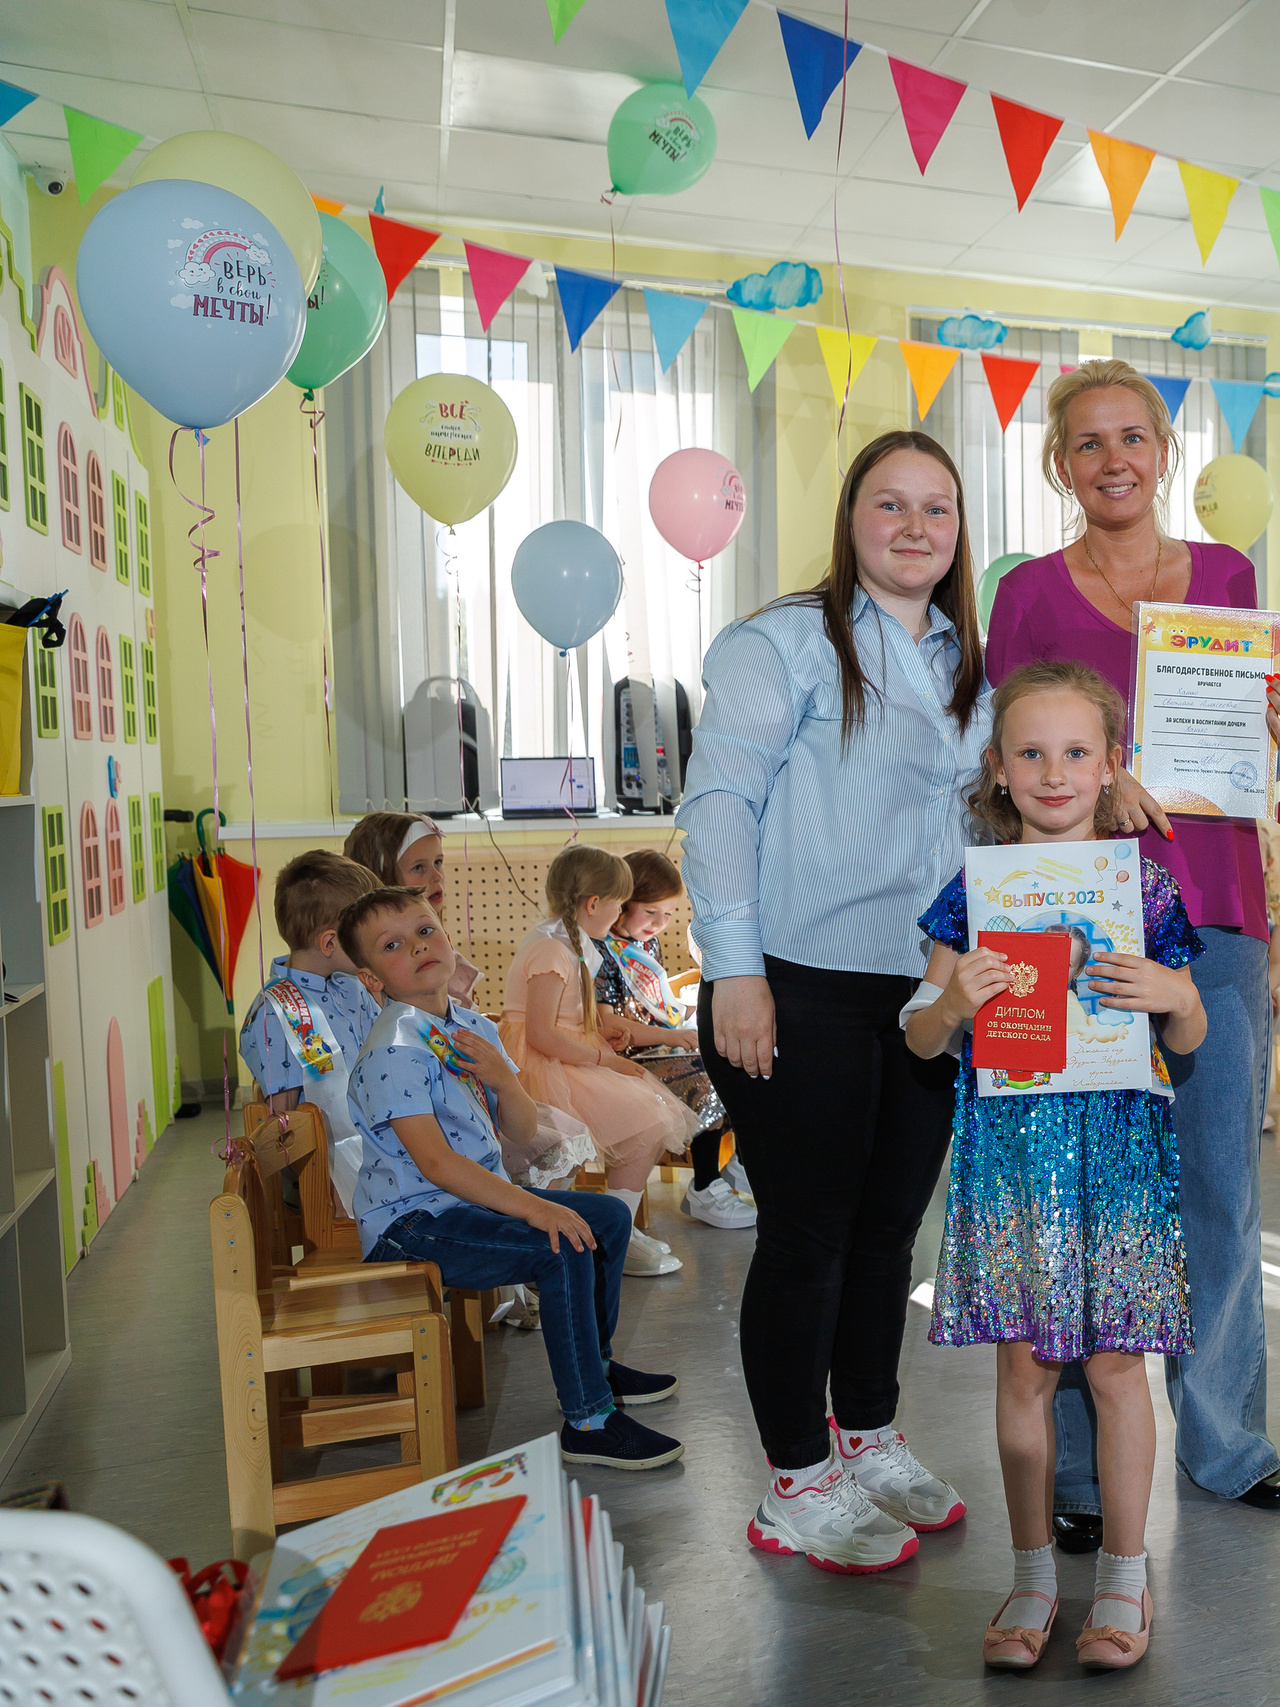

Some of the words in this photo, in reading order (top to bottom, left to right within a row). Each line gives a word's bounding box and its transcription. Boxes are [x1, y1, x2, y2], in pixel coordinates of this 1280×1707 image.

[223, 260, 267, 286] ВЕРЬ
[217, 277, 225, 294] в
[229, 281, 262, 300] свои
[192, 293, 272, 326] МЕЧТЫ!
[438, 400, 469, 420] ВСЁ
[424, 443, 480, 462] ВПЕРЕДИ
[1170, 634, 1253, 653] ЭРУДИТ
[1156, 664, 1234, 678] БЛАГОДАРСТВЕННОЕ
[1235, 670, 1266, 680] ПИСЬМО
[1197, 680, 1222, 688] ВРУЧАЕТСЯ
[1002, 891, 1065, 908] ВЫПУСК
[1067, 890, 1105, 905] 2023
[995, 1006, 1046, 1020] ДИПЛОМ
[986, 1030, 1028, 1041] ДЕТСКОГО
[1030, 1033, 1052, 1042] САДА
[987, 1021, 999, 1029] ОБ
[1000, 1021, 1053, 1033] ОКОНЧАНИИ
